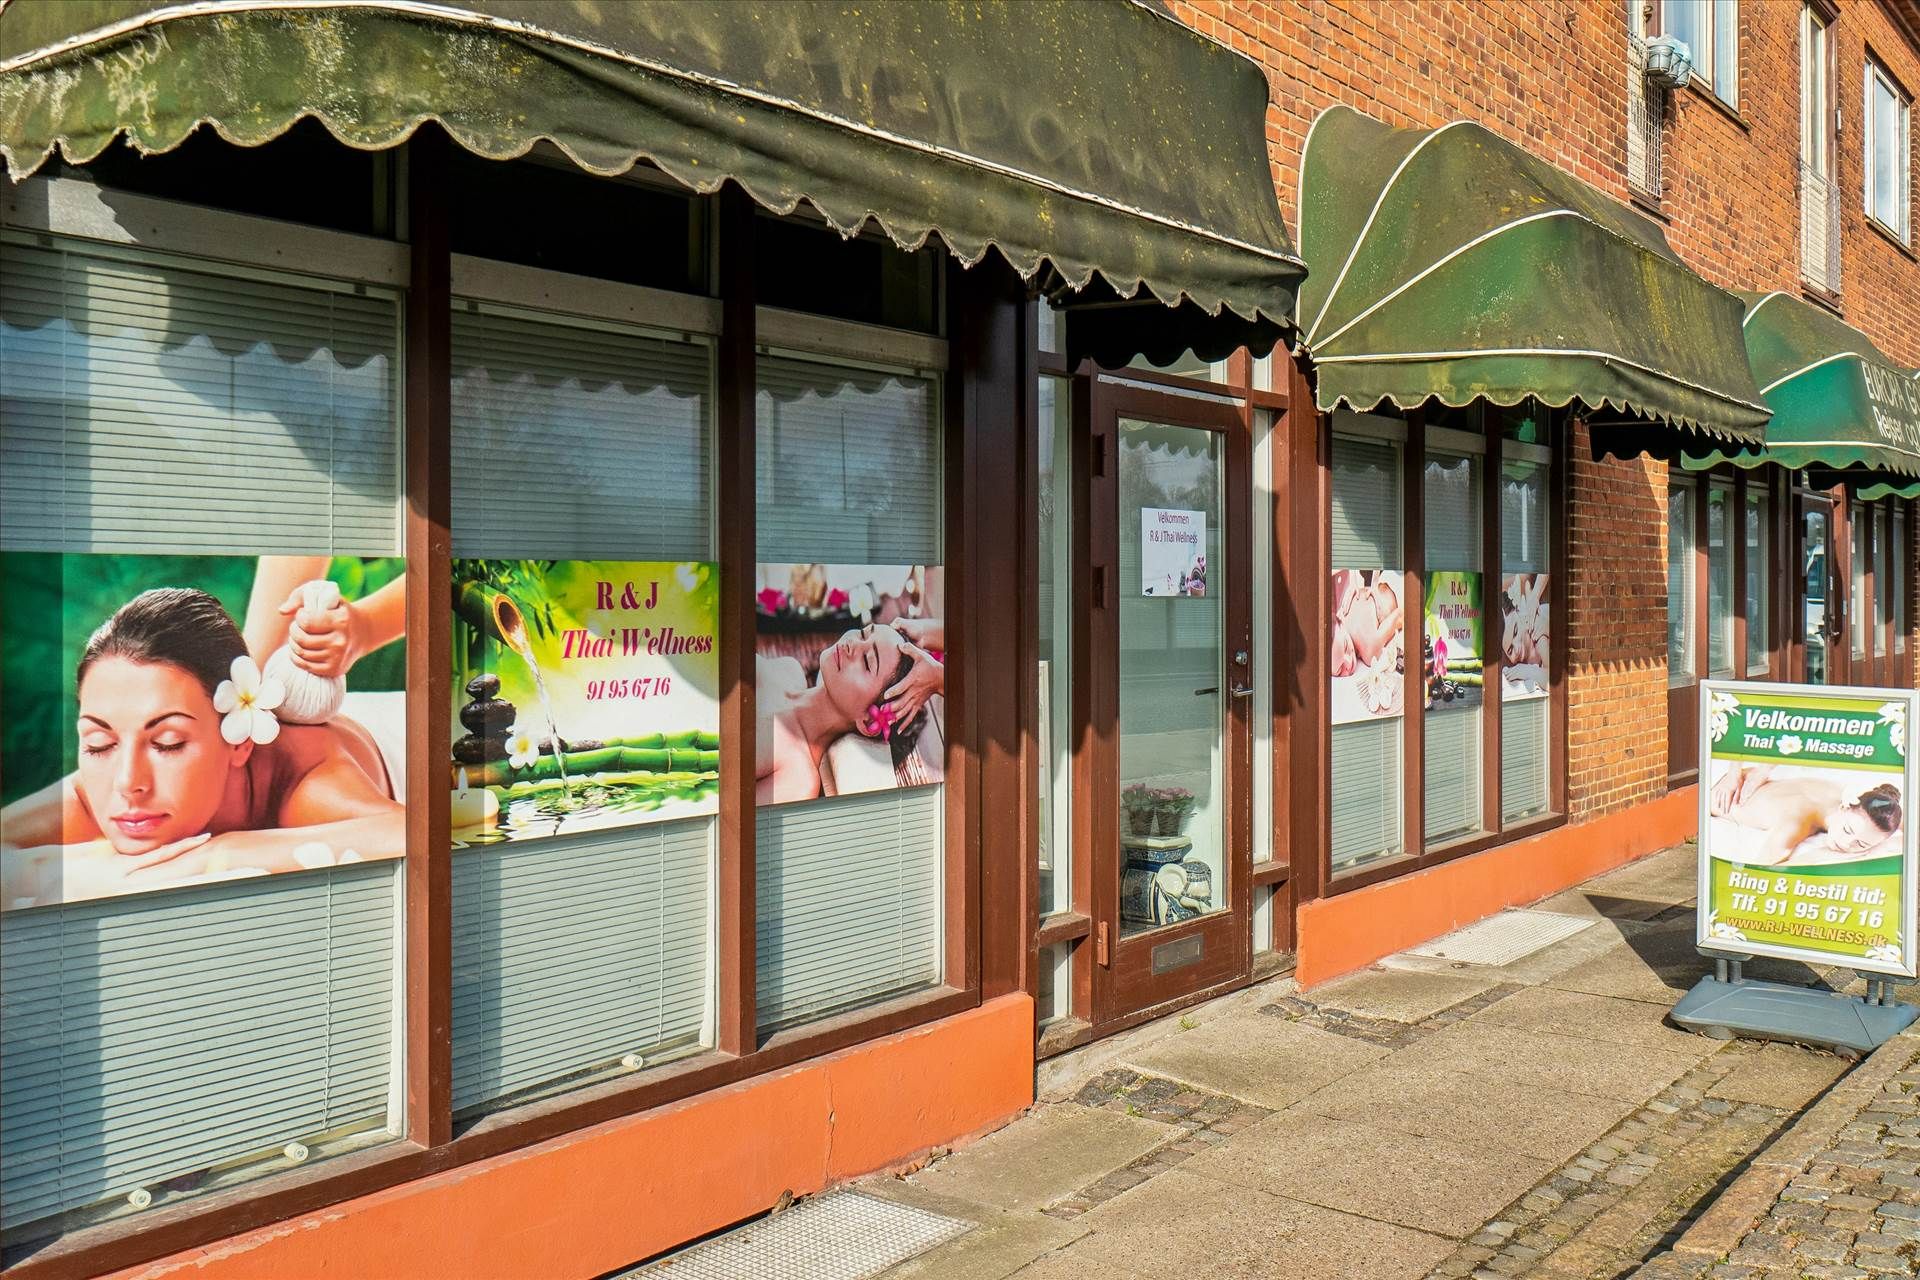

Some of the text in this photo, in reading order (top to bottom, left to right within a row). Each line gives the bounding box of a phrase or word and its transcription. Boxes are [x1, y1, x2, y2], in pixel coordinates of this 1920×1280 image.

[1861, 360, 1909, 412] EUROPA
[1872, 405, 1906, 446] Rejser
[1157, 512, 1190, 524] Velkommen
[1150, 530, 1154, 542] R
[1155, 530, 1159, 542] &
[1163, 531, 1175, 543] Thai
[1175, 531, 1198, 544] Wellness
[596, 581, 660, 610] R & J
[1451, 581, 1456, 595] R
[1463, 581, 1468, 595] J
[561, 627, 713, 659] Thai Wellness
[587, 676, 671, 701] 91 95 67 16
[1744, 709, 1875, 735] Velkommen
[1743, 734, 1875, 758] Thai Massage
[1728, 871, 1886, 905] Ring & bestil tid:
[1731, 893, 1883, 929] Tlf. 91 95 67 16
[1726, 916, 1888, 948] www.RJ-WELLNESS.dk
